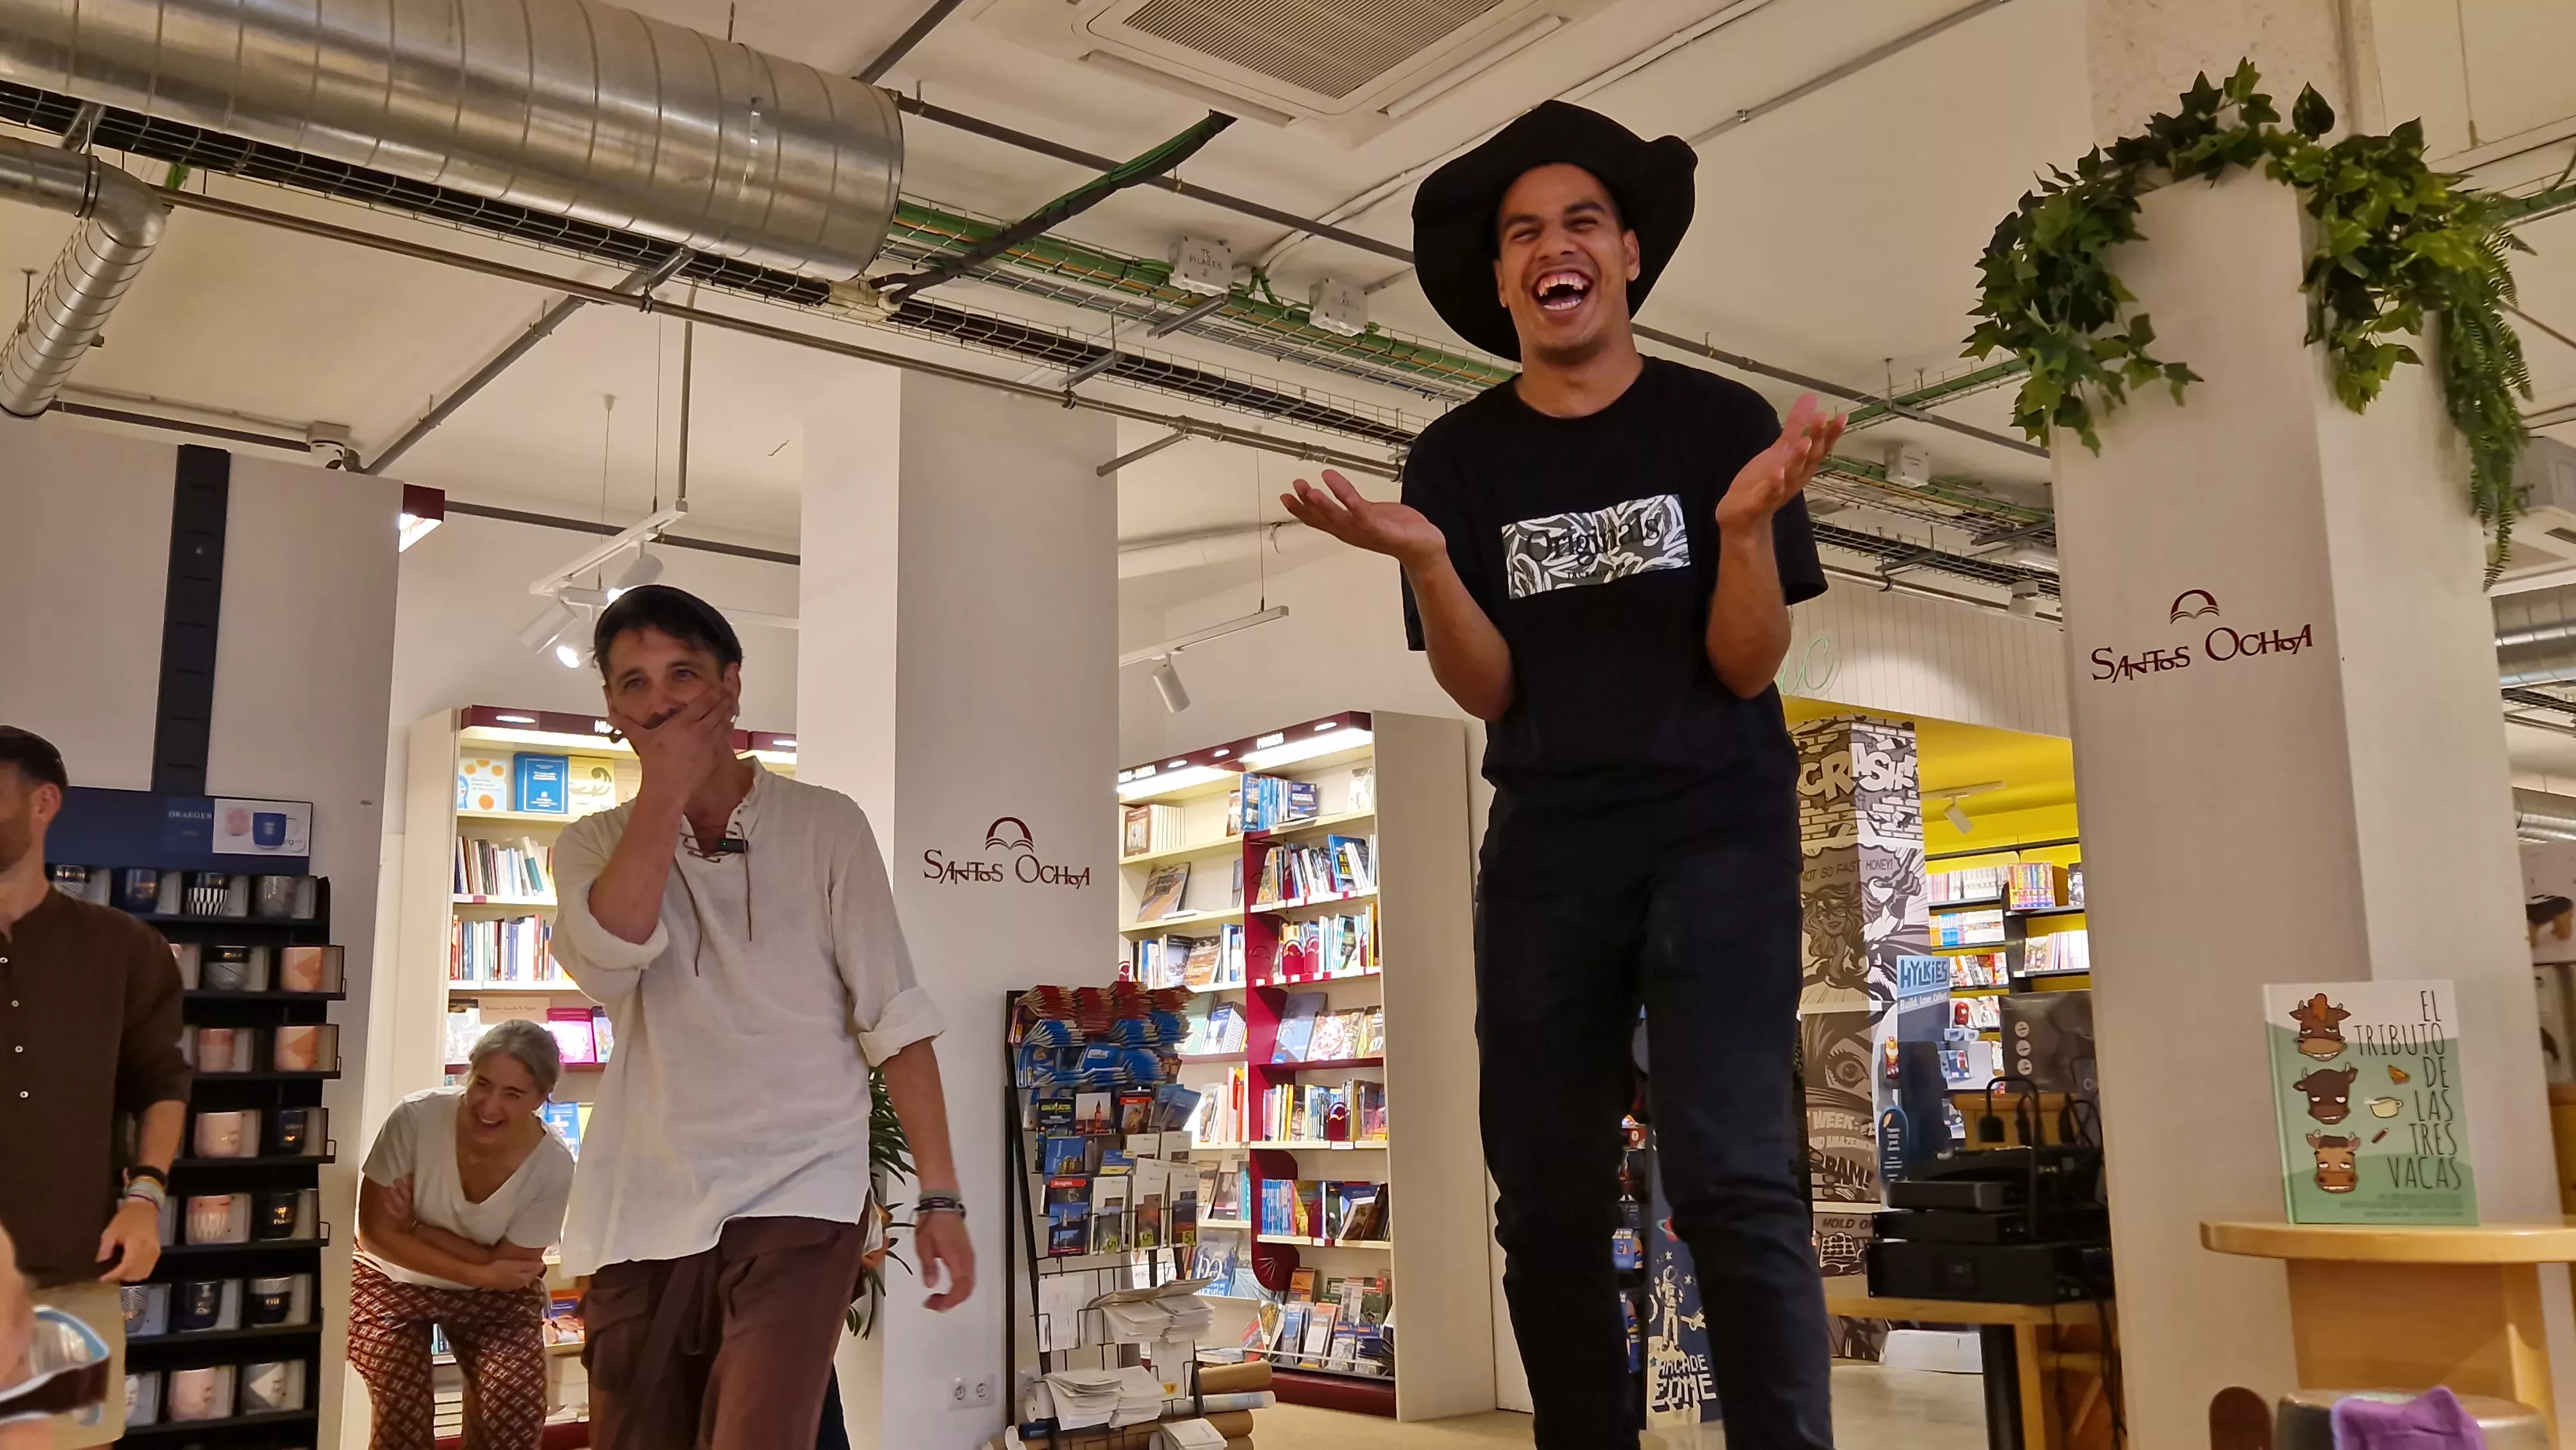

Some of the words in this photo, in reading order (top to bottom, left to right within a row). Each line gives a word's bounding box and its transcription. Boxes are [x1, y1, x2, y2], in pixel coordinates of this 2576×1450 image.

[168, 811, 213, 819] DRAEGER
[1821, 866, 1834, 879] SO
[1836, 859, 1862, 875] FAST
[1866, 858, 1893, 871] HONEY!
[2420, 990, 2441, 1022] EL
[2353, 1022, 2445, 1057] TRIBUTO
[2422, 1056, 2450, 1089] DE
[1812, 1109, 1859, 1131] WEEK:
[2414, 1088, 2453, 1123] LAS
[2409, 1122, 2458, 1156] TRES
[2386, 1156, 2462, 1190] VACAS
[1821, 1218, 1855, 1229] HOLD
[1660, 1353, 1709, 1376] ARCADE
[1653, 1373, 1718, 1408] ZONE
